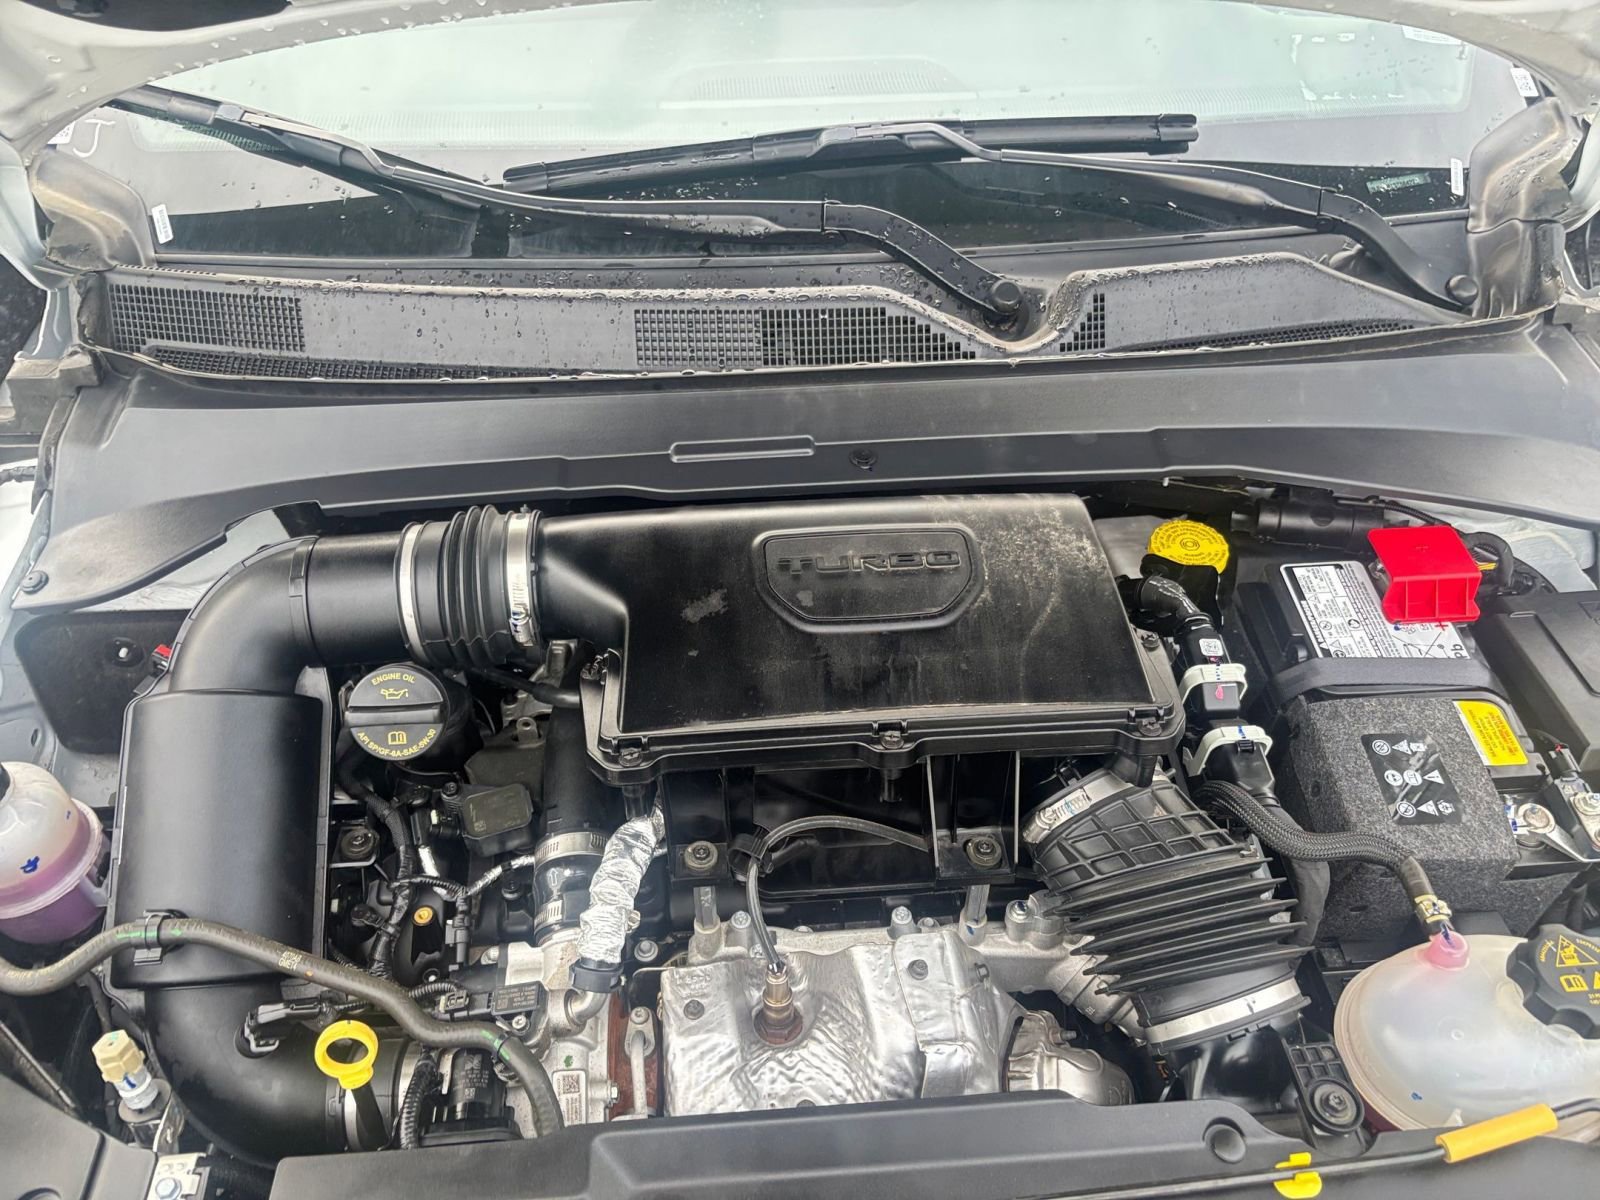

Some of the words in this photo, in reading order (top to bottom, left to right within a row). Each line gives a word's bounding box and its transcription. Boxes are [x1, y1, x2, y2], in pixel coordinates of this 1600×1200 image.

[777, 552, 961, 575] TURBO
[372, 672, 401, 686] ENGINE
[402, 673, 416, 684] OIL
[357, 732, 370, 744] API
